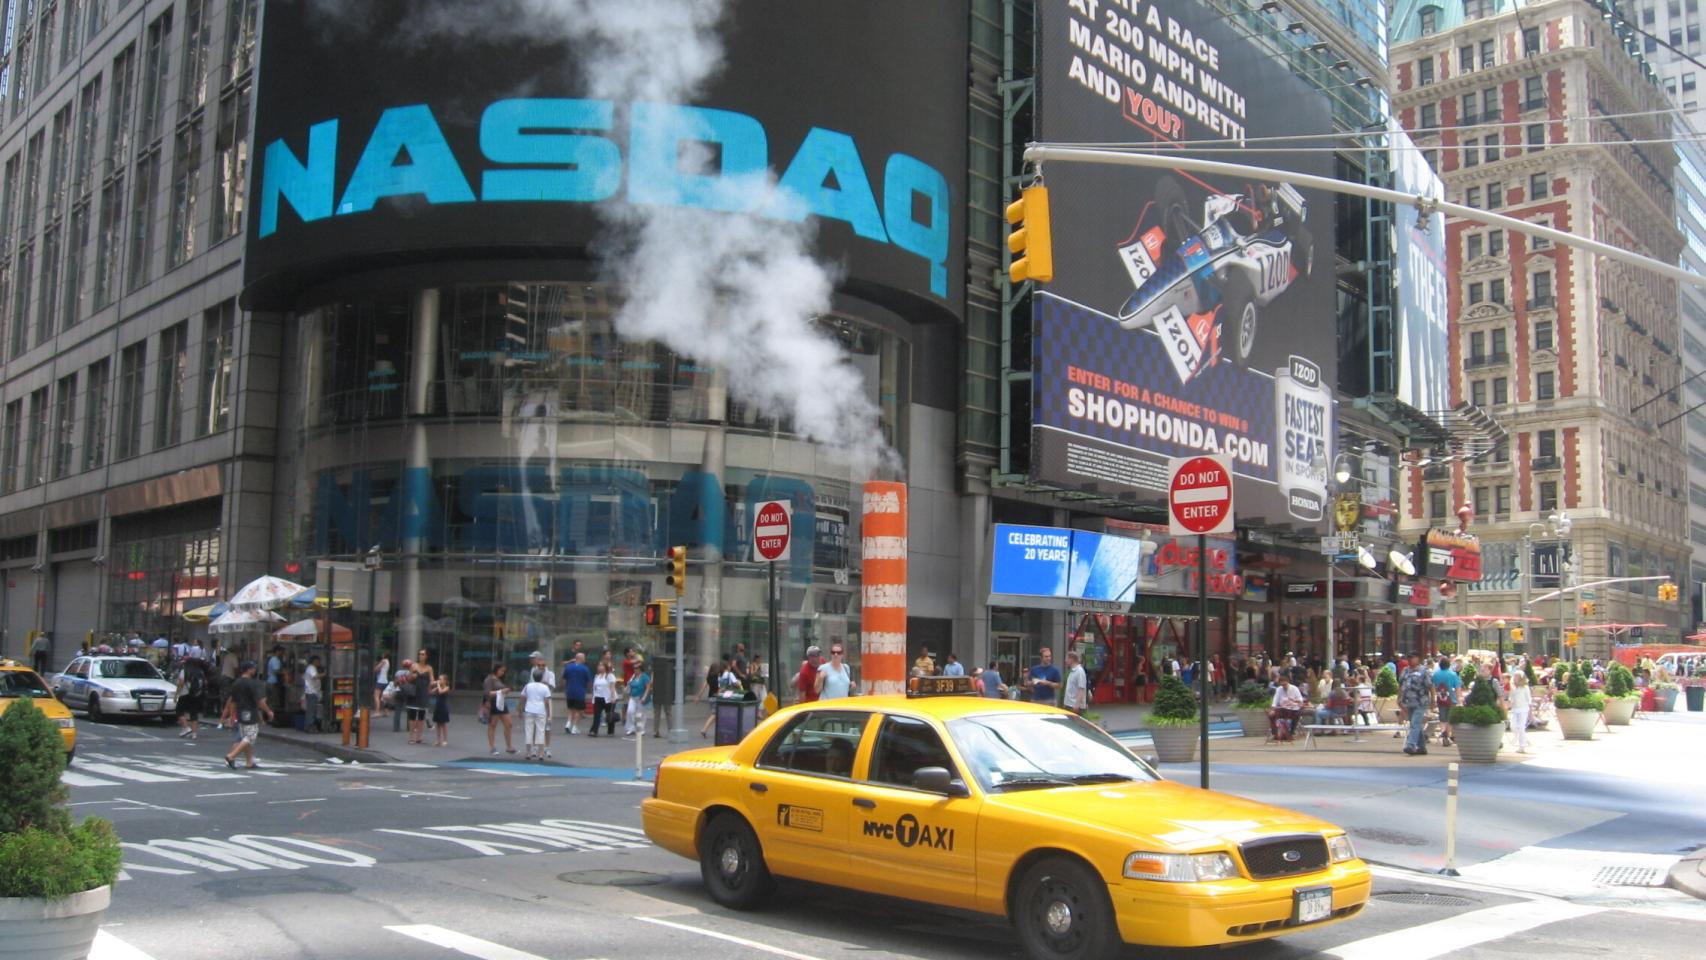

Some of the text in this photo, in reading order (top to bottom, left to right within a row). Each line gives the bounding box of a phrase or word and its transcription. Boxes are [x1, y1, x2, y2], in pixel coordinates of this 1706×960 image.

[1146, 4, 1219, 71] A RACE
[1068, 0, 1246, 119] AT 200 MPH WITH
[1069, 17, 1246, 148] MARIO ANDRETTI
[1069, 55, 1182, 139] AND YOU?
[259, 98, 949, 298] NASDAQ
[1128, 247, 1150, 280] IZO
[1258, 250, 1291, 295] IZOD
[1293, 362, 1317, 384] IZOD
[1067, 365, 1111, 391] ENTER
[1114, 379, 1139, 399] FOR
[1141, 389, 1151, 404] A
[1153, 391, 1201, 419] CHANCE
[1202, 407, 1218, 423] TO
[1218, 412, 1240, 430] WIN
[1067, 387, 1269, 468] SHOPHONDA.COM
[1284, 392, 1325, 438] FASTEST
[1284, 429, 1325, 465] SEAT
[1179, 470, 1220, 486] DO NOT
[1285, 463, 1294, 476] IN
[1183, 504, 1218, 519] ENTER
[1291, 496, 1320, 511] HONDA
[760, 513, 783, 523] DO NOT
[761, 539, 781, 549] ENTER
[1008, 532, 1068, 547] CELEBRATING
[1024, 549, 1036, 560] 20
[1037, 549, 1066, 562] YEARS
[936, 680, 954, 692] 3F39
[863, 820, 894, 841] NYC
